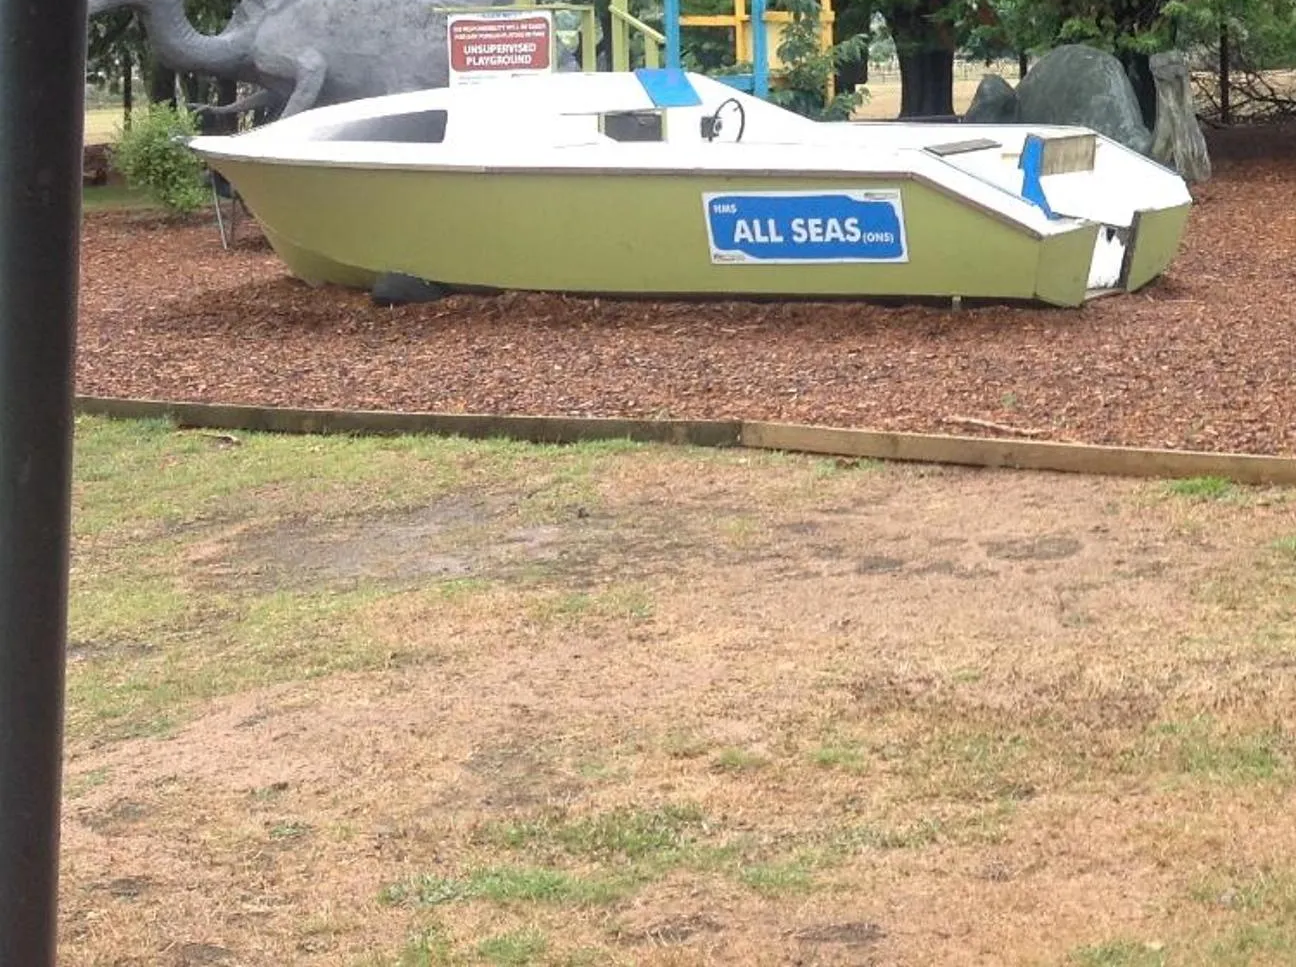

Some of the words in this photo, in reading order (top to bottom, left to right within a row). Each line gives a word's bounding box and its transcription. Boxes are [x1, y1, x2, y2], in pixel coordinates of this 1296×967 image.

[463, 43, 537, 55] UNSUPERVISED
[466, 54, 532, 66] PLAYGROUND
[712, 204, 738, 214] HMS
[733, 218, 784, 243] ALL
[790, 217, 862, 243] SEAS
[862, 232, 895, 245] (ONS)
